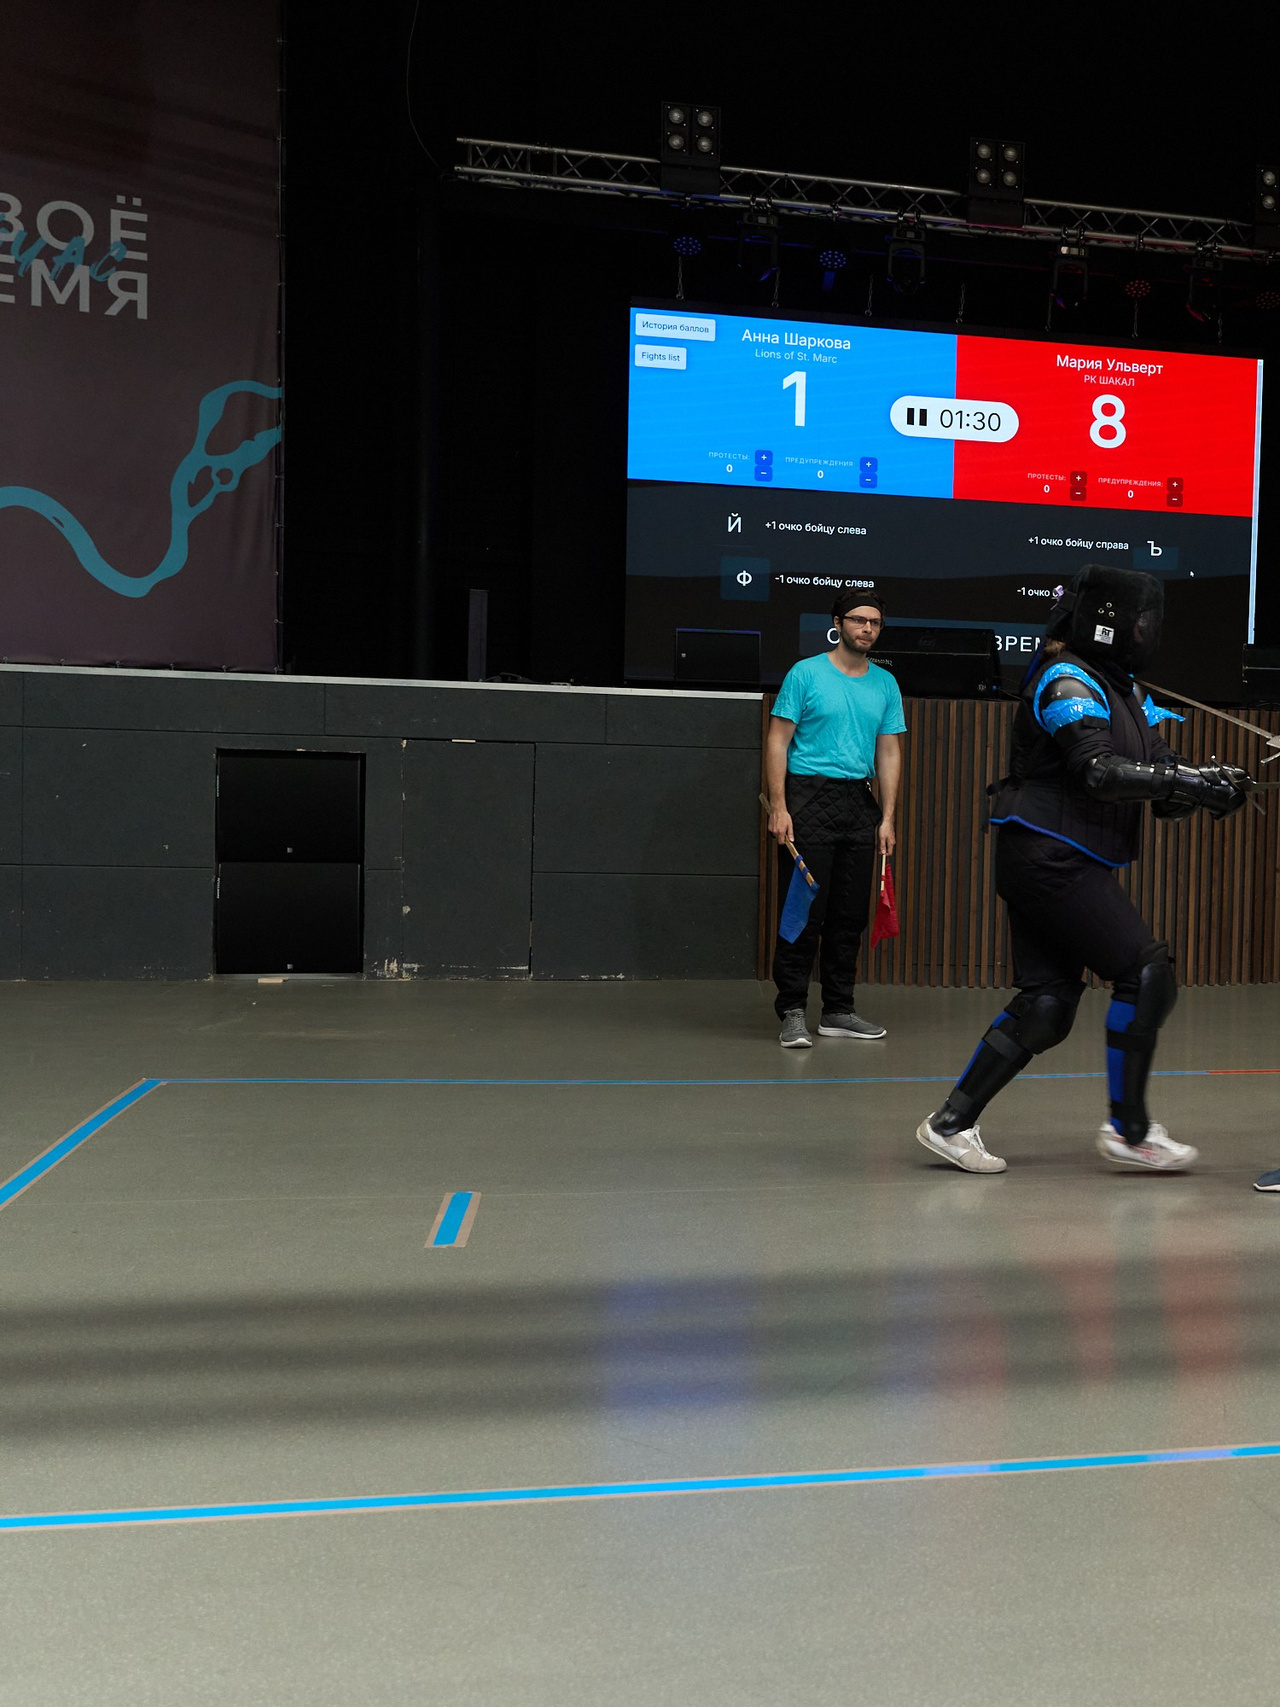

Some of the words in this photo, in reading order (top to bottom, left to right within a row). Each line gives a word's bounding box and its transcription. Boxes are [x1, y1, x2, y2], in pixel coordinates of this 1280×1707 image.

[642, 320, 678, 331] История
[679, 323, 710, 333] баллов
[741, 328, 780, 344] Анна
[784, 332, 851, 350] Шаркова
[641, 351, 666, 362] Fights
[668, 353, 681, 362] list
[754, 348, 782, 360] Lions
[783, 350, 795, 360] of
[796, 351, 810, 362] St.
[812, 352, 838, 364] Marc
[1056, 354, 1103, 372] Мария
[1106, 358, 1164, 377] Ульверт
[1083, 374, 1097, 384] РК
[1098, 375, 1135, 387] ШАКАЛ
[782, 370, 807, 427] 1
[939, 409, 1001, 432] 01:30
[1089, 394, 1127, 449] 8
[726, 463, 733, 473] 0
[817, 469, 824, 479] 0
[1043, 484, 1051, 493] 0
[1127, 489, 1134, 499] 0
[727, 512, 742, 533] Й
[765, 520, 776, 530] +1
[778, 522, 803, 532] очко
[804, 522, 836, 536] бойцу
[837, 526, 867, 535] слева
[1028, 536, 1039, 545] +1
[1040, 538, 1064, 547] очко
[1065, 538, 1094, 550] бойцу
[1095, 541, 1129, 551] справа
[1146, 540, 1163, 557] Ъ
[736, 569, 753, 587] Ф
[774, 574, 784, 584] -1
[786, 576, 811, 585] очко
[812, 576, 843, 589] бойцу
[844, 579, 875, 588] слева
[1016, 586, 1026, 596] -1
[1027, 588, 1051, 597] очко
